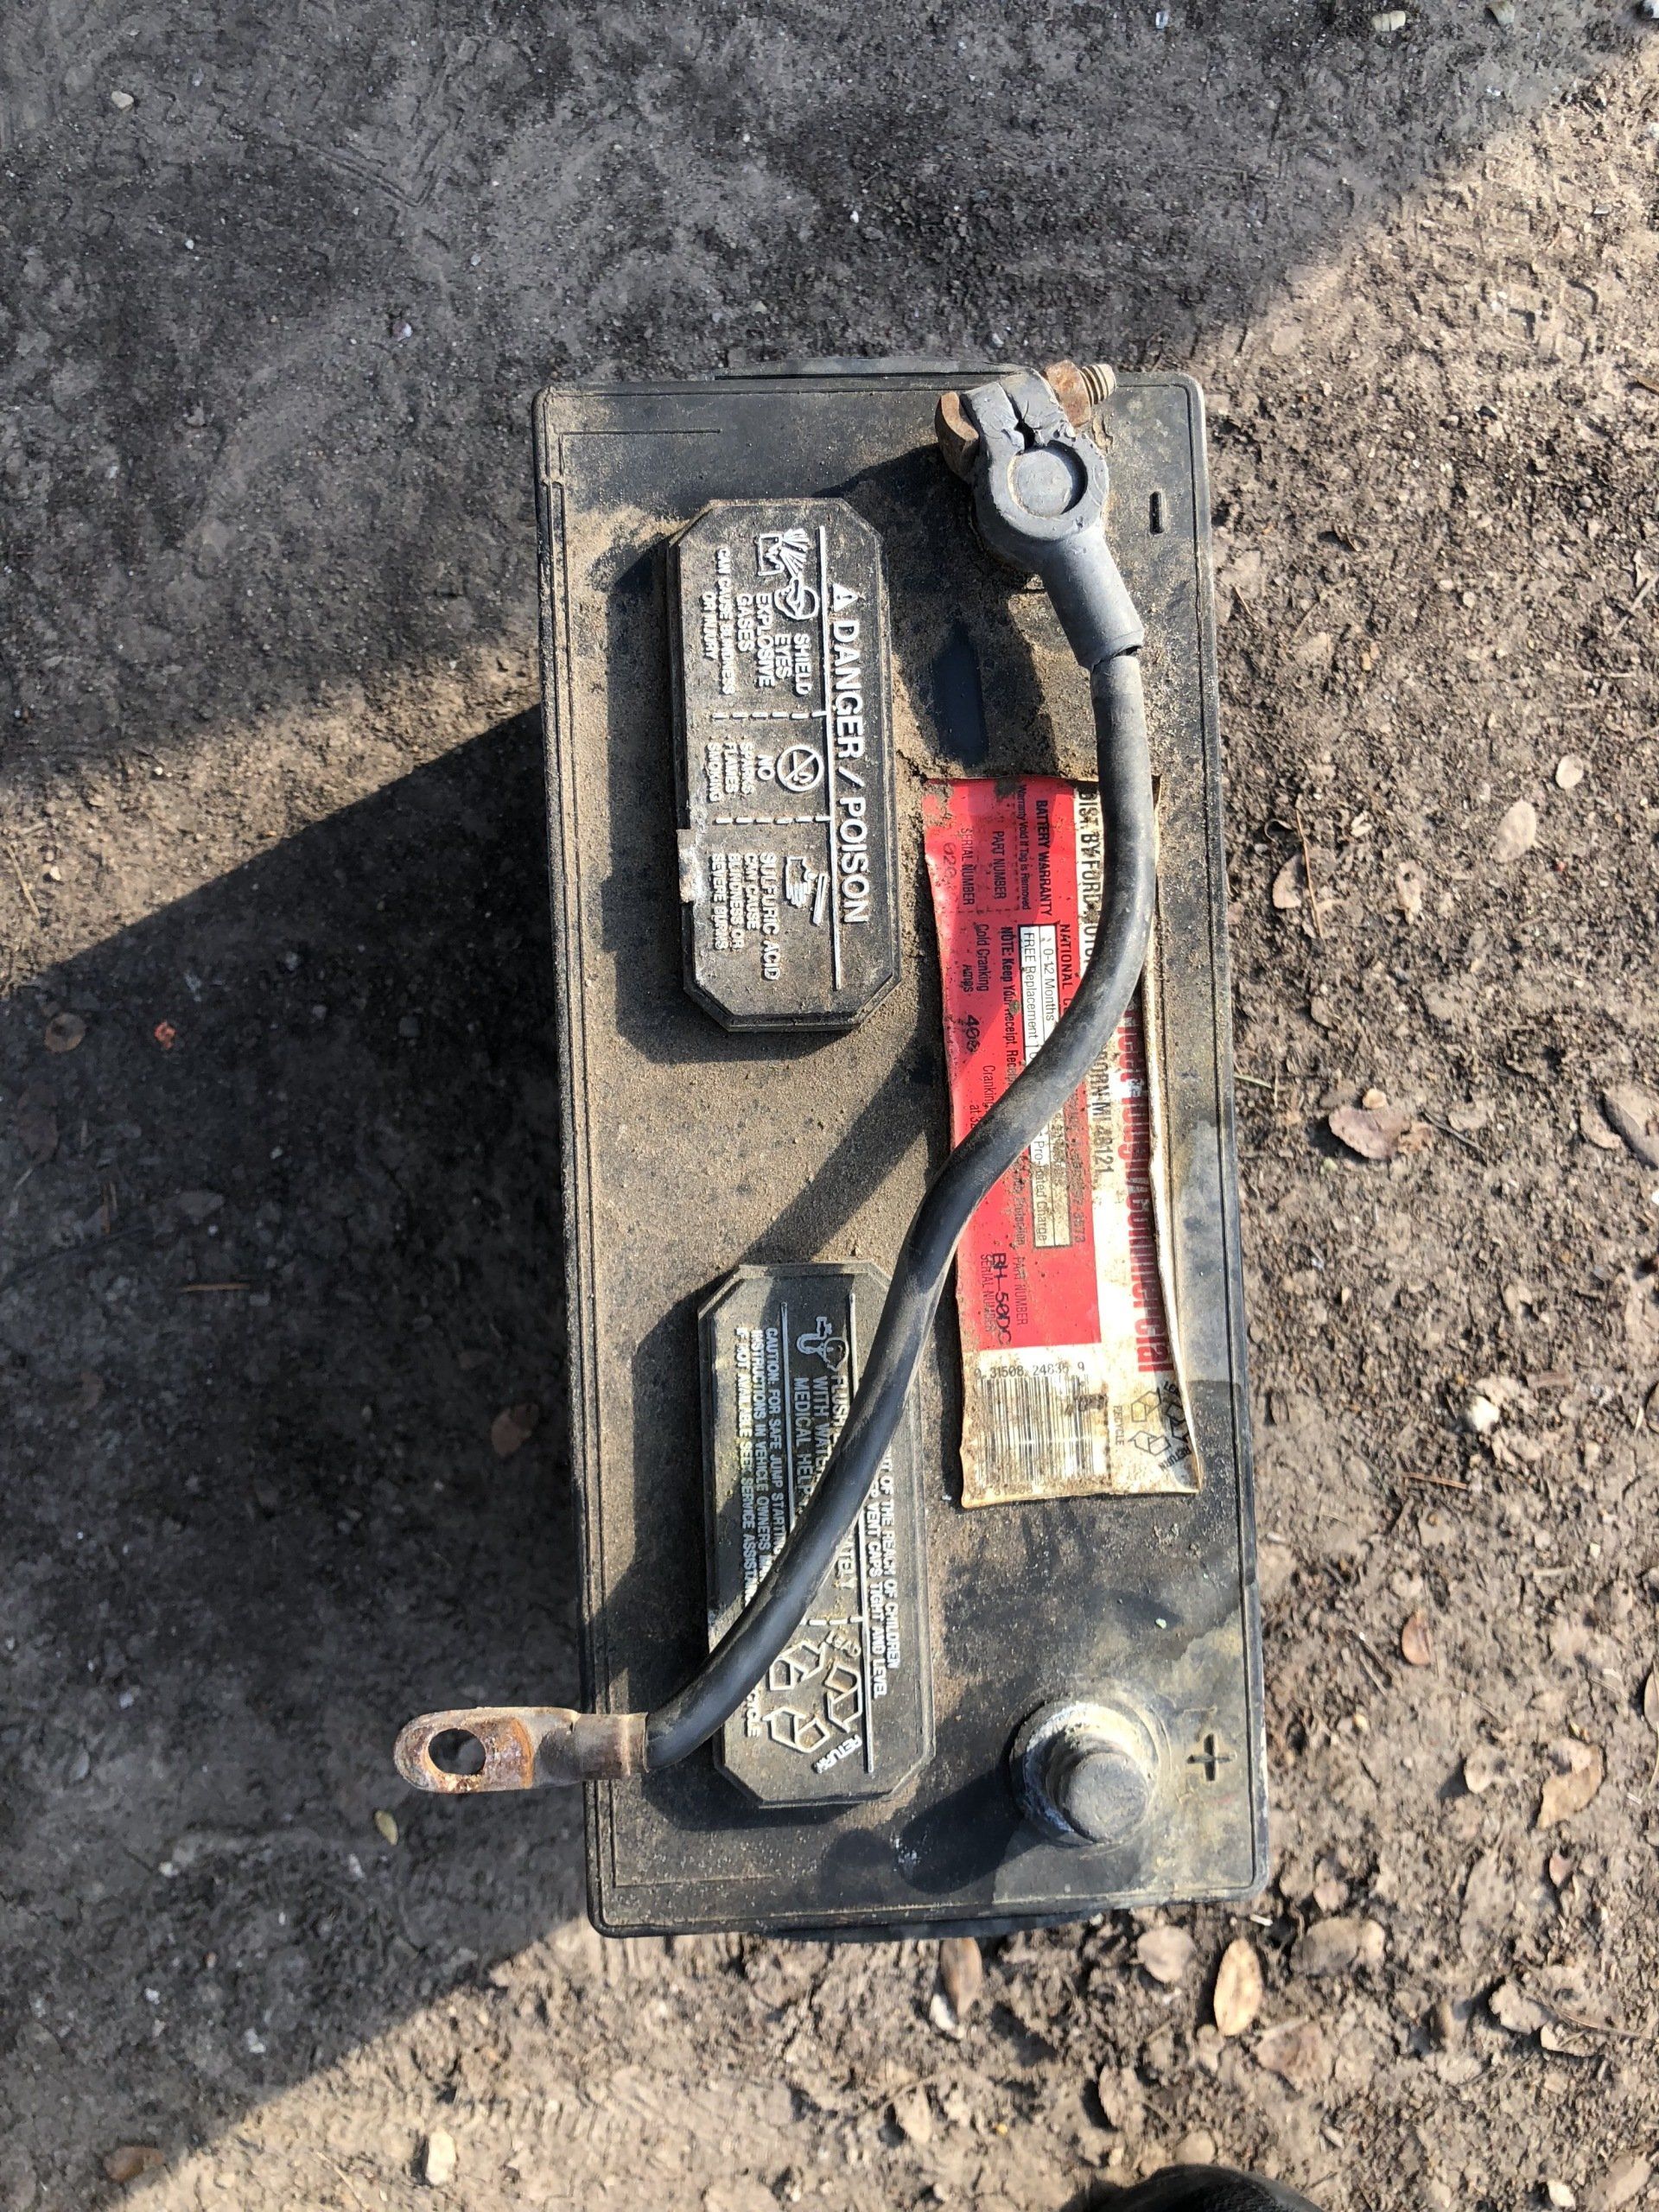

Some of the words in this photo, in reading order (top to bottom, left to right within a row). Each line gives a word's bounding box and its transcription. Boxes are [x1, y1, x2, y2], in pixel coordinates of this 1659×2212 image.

[716, 548, 731, 575] CAN
[701, 593, 716, 612] OR
[717, 579, 734, 620] CAUSE
[702, 614, 719, 660] INJURY
[736, 593, 755, 652] GASES
[755, 593, 774, 687] EXPLOSIVE
[721, 622, 736, 695] BLINDNESS
[773, 634, 792, 680] EYES
[793, 633, 811, 695] SHIELD
[832, 620, 864, 759] DANGER
[706, 741, 724, 801] SMOKING
[722, 741, 740, 793] FLAMES
[738, 741, 754, 794] SPARKS
[757, 753, 774, 781] NO
[1016, 785, 1028, 820] Warranty
[961, 828, 974, 861] SERIAL
[993, 831, 1005, 855] PART
[1035, 800, 1051, 849] BATTERY
[1080, 833, 1101, 856] BY
[742, 852, 759, 883] CAN
[839, 798, 869, 924] POISON
[1018, 849, 1030, 862] Tag
[710, 852, 728, 902] SEVERE
[727, 852, 745, 925] BLINDNESS
[759, 852, 779, 936] SULFURIC
[962, 864, 976, 906] NUMBER
[993, 858, 1007, 899] NUMBER
[1020, 874, 1033, 910] Removed
[1038, 851, 1052, 916] WARRANTY
[1081, 861, 1103, 906] FORD
[712, 905, 729, 950] BURNS
[744, 887, 761, 931] CAUSE
[729, 929, 746, 950] OR
[975, 924, 990, 945] Cold
[1001, 926, 1016, 956] NOTE:
[1023, 932, 1037, 963] FREE
[763, 940, 781, 981] ACID
[976, 949, 992, 992] Cranking
[1000, 958, 1017, 982] Keep
[1044, 948, 1057, 975] 0-12
[1059, 924, 1074, 990] NATIONAL
[1023, 966, 1040, 1039] Replacement
[1045, 978, 1058, 1021] Months
[1034, 1201, 1052, 1241] Charge
[980, 1254, 995, 1287] SERIAL
[1013, 1256, 1026, 1281] PART
[982, 1290, 997, 1332] NUMBER
[1014, 1284, 1028, 1325] NUMBER
[736, 1327, 750, 1341] IF
[737, 1344, 750, 1370] NOT
[750, 1330, 766, 1420] INSTRUCTIONS
[765, 1326, 779, 1385] CAUTION:
[990, 1364, 1024, 1379] 31508
[737, 1372, 753, 1437] AVAILABLE
[767, 1389, 780, 1415] FOR
[793, 1377, 812, 1446] MEDICAL
[812, 1375, 830, 1417] WITH
[830, 1375, 849, 1427] FLUSH
[753, 1424, 767, 1438] IN
[768, 1417, 782, 1450] SAFE
[1112, 1405, 1125, 1446] RECYCLE
[739, 1440, 753, 1473] SEEK
[754, 1440, 770, 1491] VEHICLE
[769, 1453, 784, 1488] JUMP
[796, 1452, 814, 1496] HELP
[741, 1477, 757, 1529] SERVICE
[880, 1475, 894, 1496] OF
[755, 1495, 772, 1551] OWNERS
[866, 1502, 881, 1537] VENT
[880, 1499, 896, 1529] THE
[868, 1541, 883, 1578] CAPS
[881, 1531, 897, 1575] REACH
[868, 1581, 884, 1621] TIGHT
[883, 1579, 899, 1599] OF
[871, 1625, 886, 1655] AND
[885, 1601, 900, 1669] CHILDREN
[872, 1658, 887, 1700] LEVEL
[811, 1733, 863, 1775] RETURN
